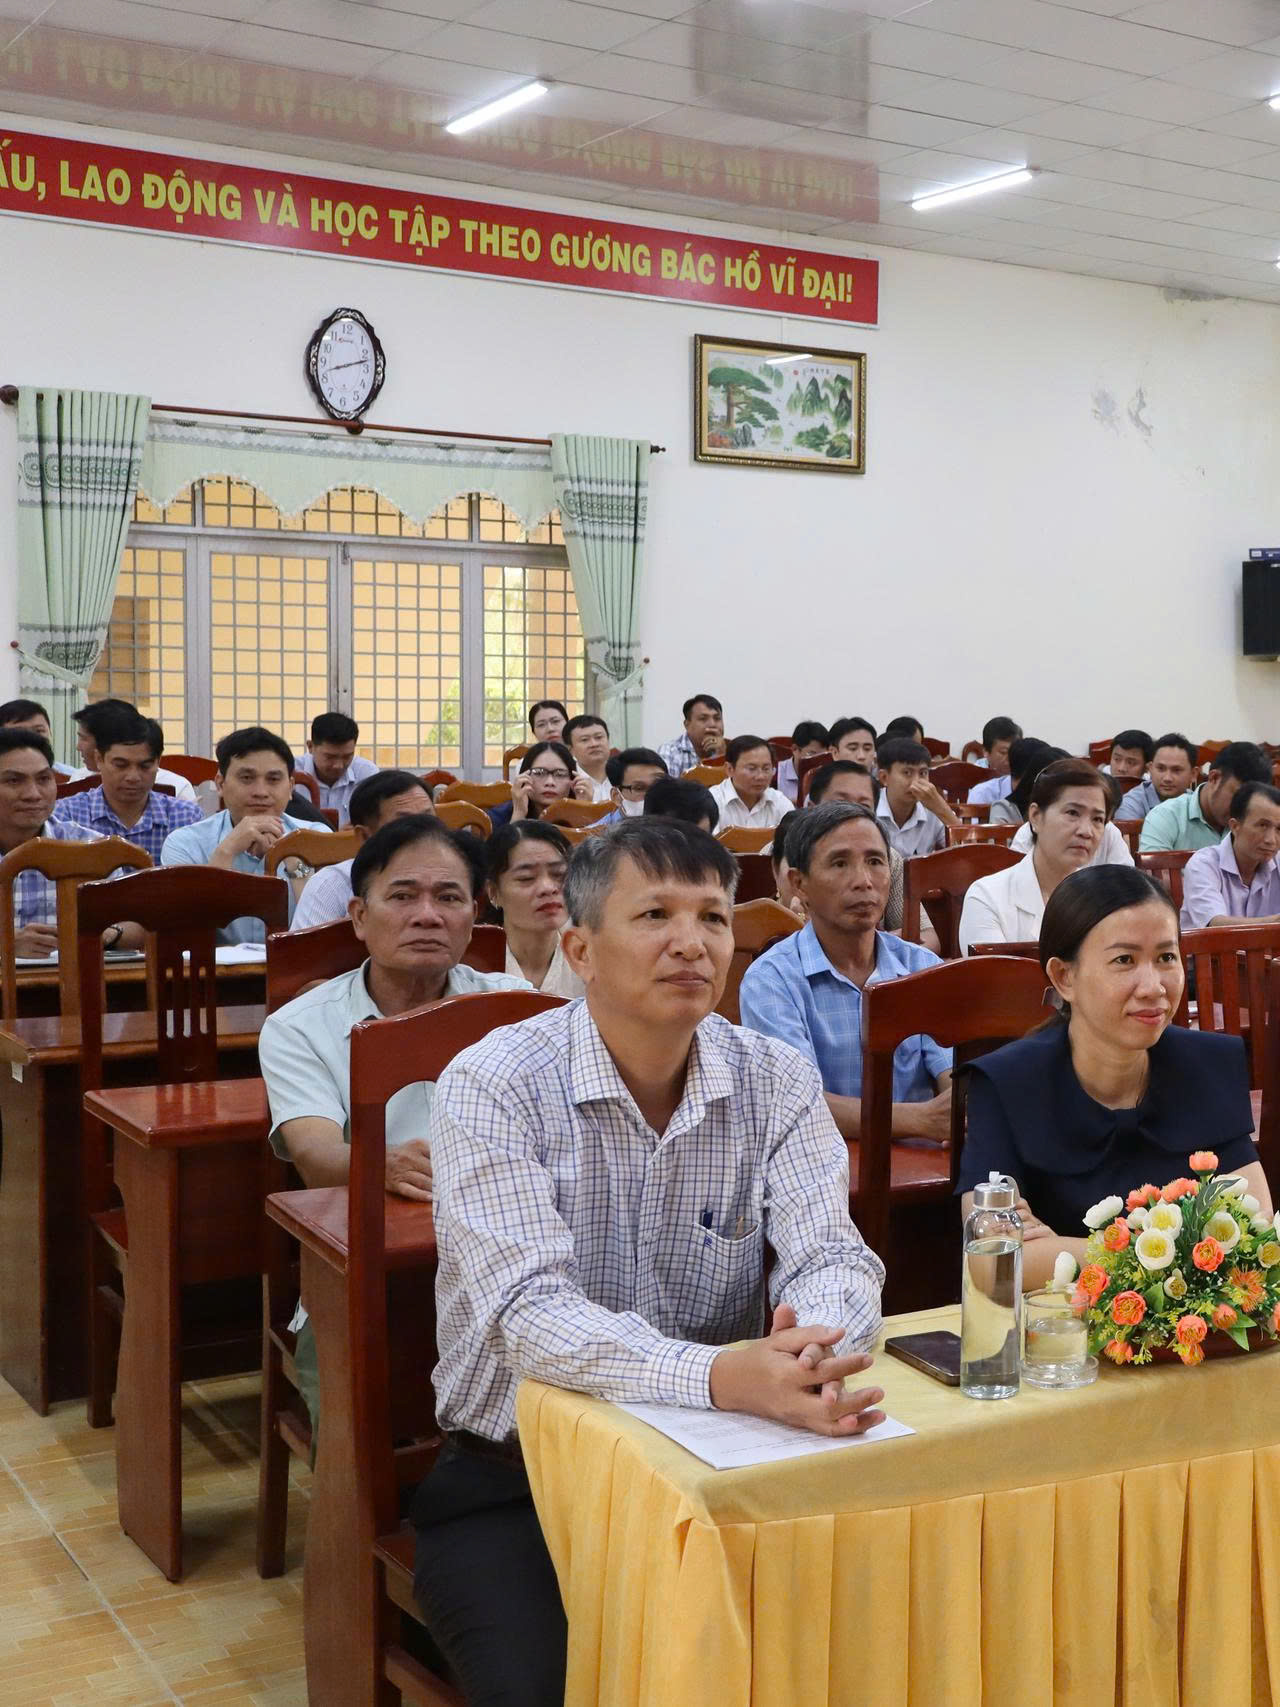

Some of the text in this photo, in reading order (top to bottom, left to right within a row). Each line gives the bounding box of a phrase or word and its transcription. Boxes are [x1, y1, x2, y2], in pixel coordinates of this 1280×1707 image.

[59, 159, 132, 206] LAO
[141, 168, 242, 225] ĐỘNG
[253, 183, 301, 229] VÀ
[309, 197, 380, 247] HỌC
[387, 204, 452, 257] TẬP
[458, 219, 543, 263] THEO
[549, 231, 653, 277] GƯƠNG
[659, 243, 717, 286] BÁC
[722, 249, 762, 293] HỒ
[768, 256, 796, 297] VĨ
[801, 267, 854, 310] ĐẠI!
[342, 324, 353, 335] 12
[331, 331, 337, 341] 11
[323, 343, 332, 354] 10
[361, 348, 369, 359] 2
[320, 358, 327, 368] 9
[362, 364, 370, 374] 3
[321, 372, 329, 384] 8
[327, 387, 334, 398] 7
[352, 391, 360, 402] 5
[339, 397, 346, 407] 6
